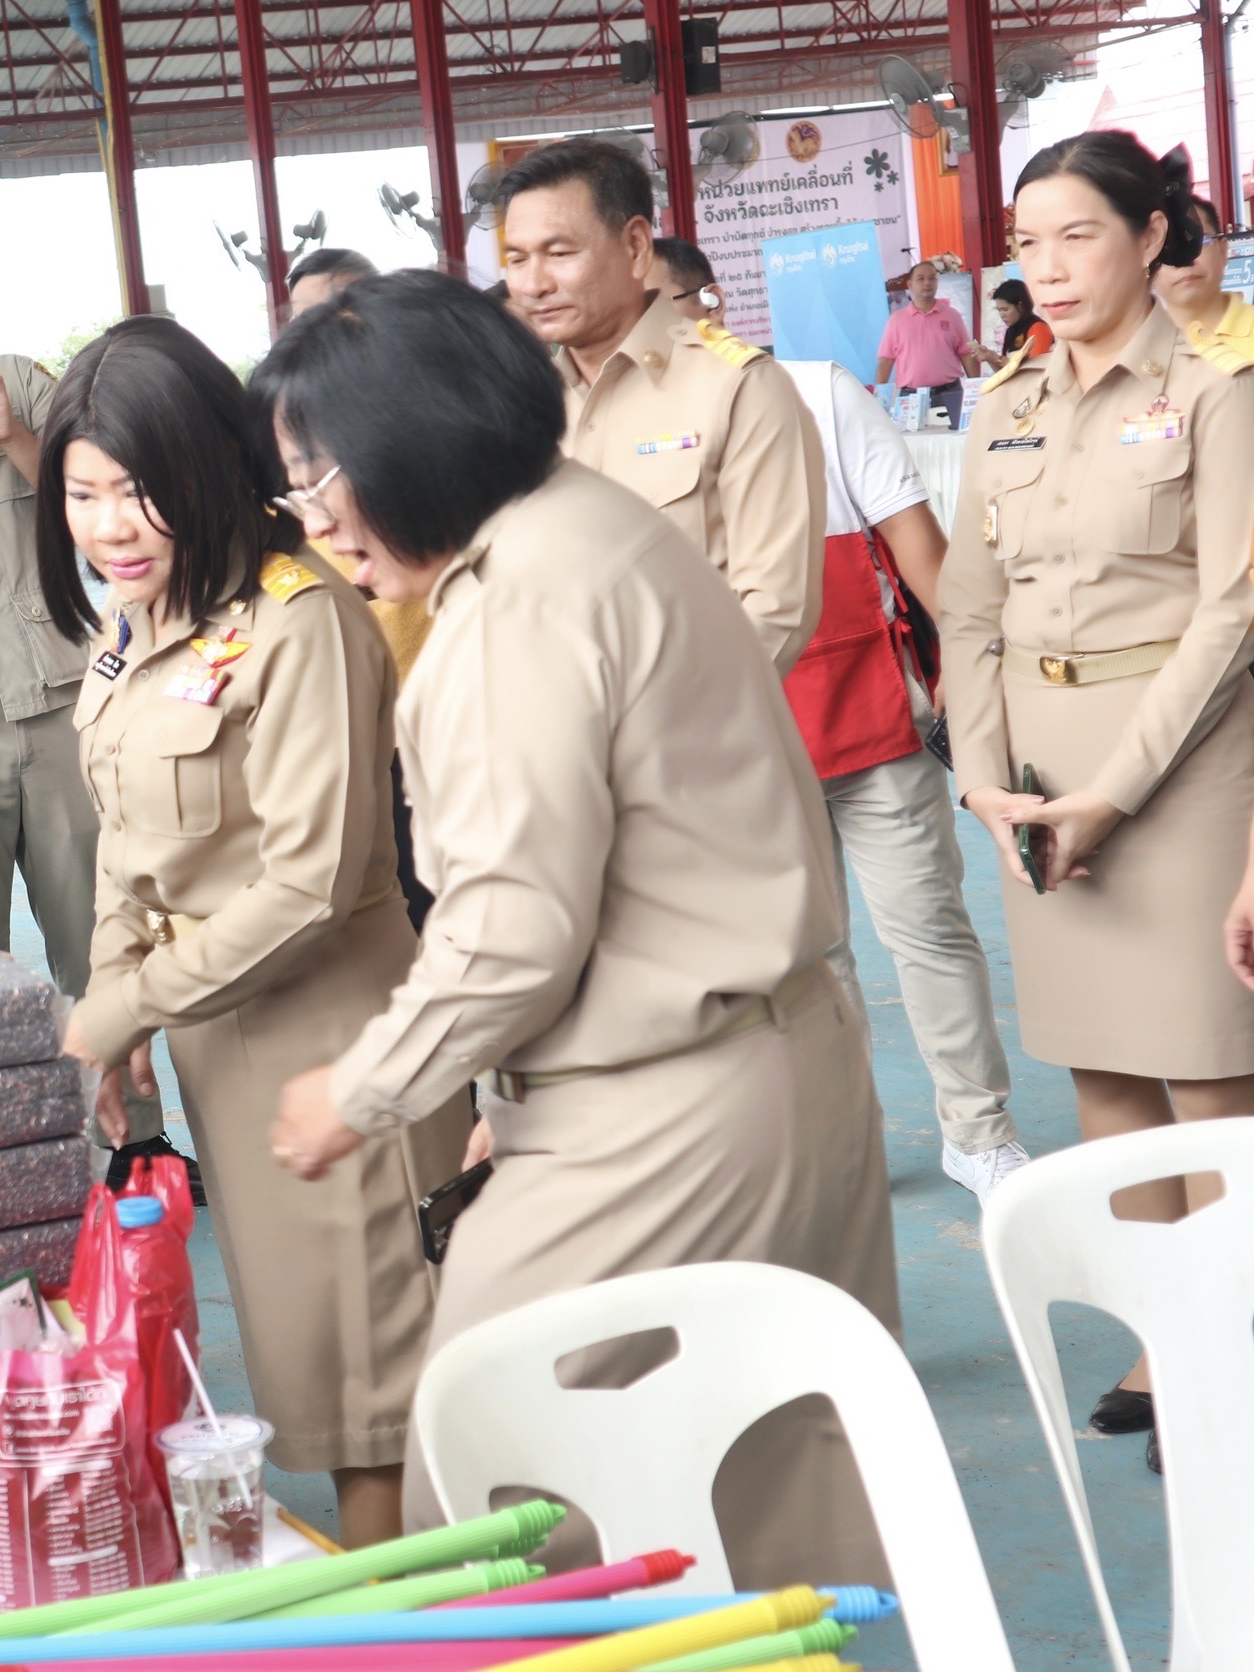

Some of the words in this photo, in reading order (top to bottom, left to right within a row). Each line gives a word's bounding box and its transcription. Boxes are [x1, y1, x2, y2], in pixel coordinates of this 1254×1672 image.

[704, 195, 839, 224] จังหวัดฉะเชิงเทรา
